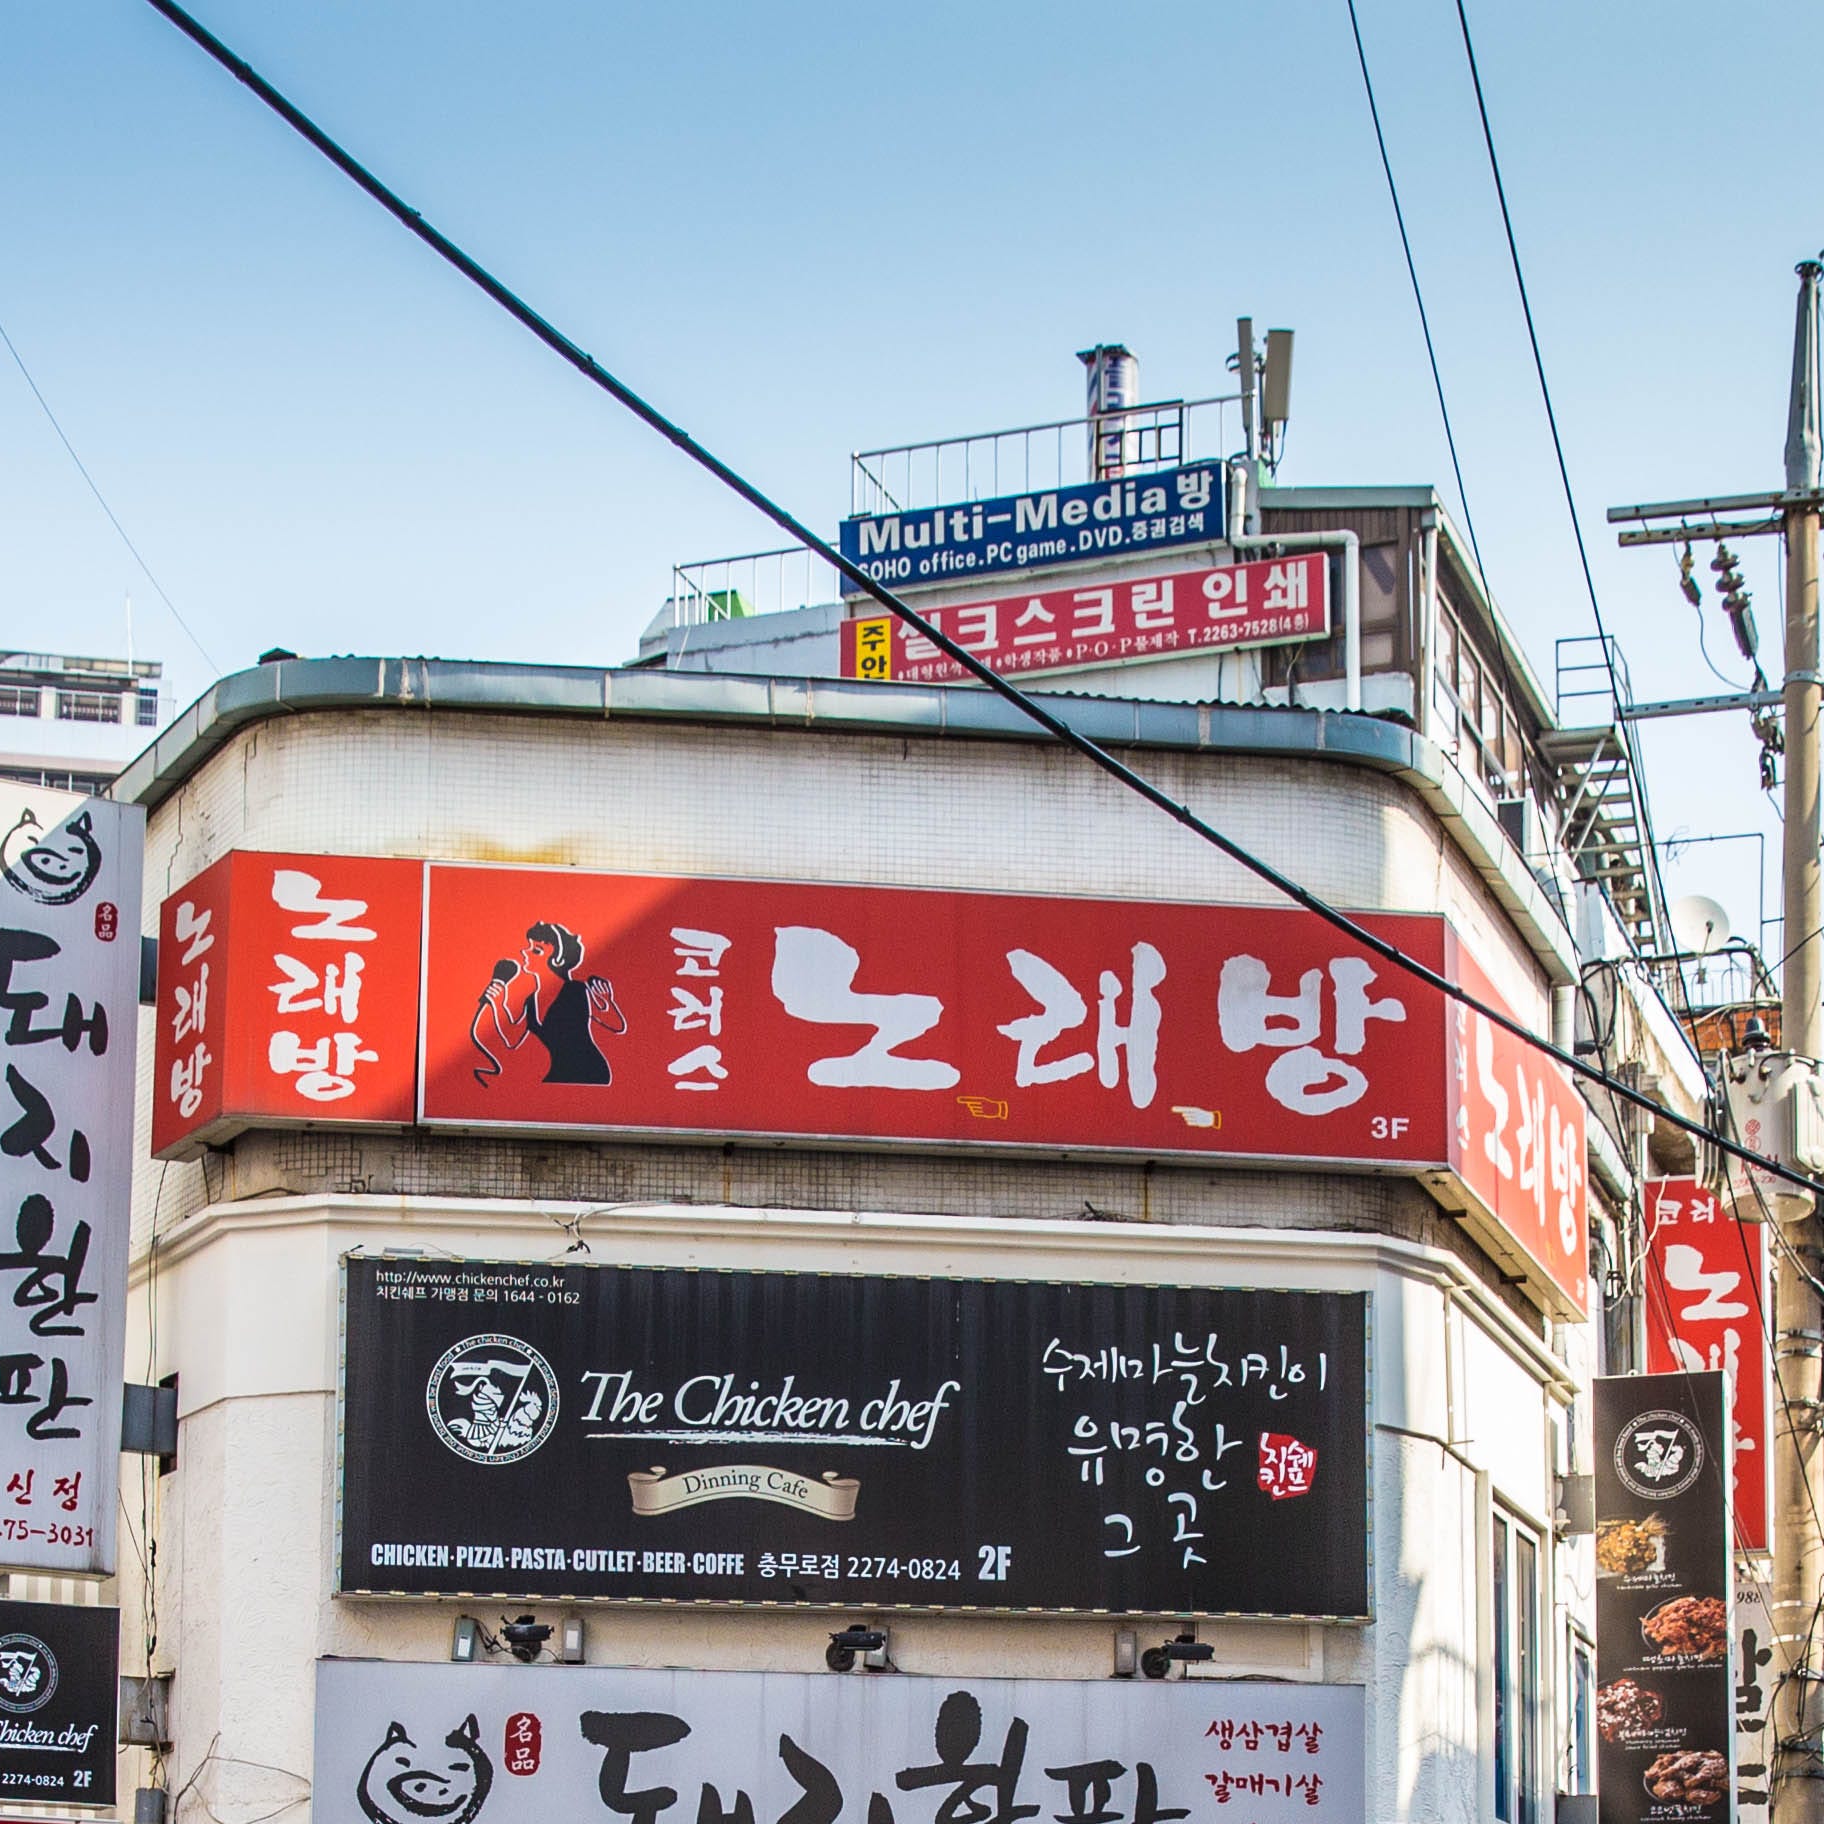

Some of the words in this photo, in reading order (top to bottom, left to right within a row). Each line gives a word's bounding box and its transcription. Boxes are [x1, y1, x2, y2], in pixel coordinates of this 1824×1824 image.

[858, 482, 1174, 556] Multi-Media
[1177, 470, 1214, 512] 방
[1201, 565, 1308, 618] 인쇄
[170, 899, 215, 1120] 노래방
[268, 868, 379, 1101] 노래방
[773, 925, 1407, 1116] 노래방
[1371, 1117, 1411, 1140] 3F
[1476, 1012, 1582, 1257] 노래방
[376, 1270, 565, 1289] http://www.chickenchef.co.kr
[503, 1290, 535, 1303] 1644
[548, 1290, 580, 1304] 0162
[581, 1371, 658, 1424] The
[674, 1372, 853, 1431] Chicken
[859, 1379, 962, 1449] chef
[1067, 1401, 1244, 1490] 유명한
[683, 1471, 762, 1497] Dinning
[766, 1472, 810, 1500] Cafe
[1103, 1515, 1141, 1558] 그
[1167, 1493, 1208, 1571] 곳
[757, 1552, 840, 1580] 충무로점
[847, 1557, 962, 1581] 2274-0824
[978, 1545, 1012, 1581] 2F
[56, 1722, 98, 1752] chef
[509, 1715, 536, 1772] 名品
[1204, 1719, 1323, 1757] 생삼겹살
[1, 1772, 65, 1788] 2274-0824
[73, 1769, 93, 1789] 2F
[1204, 1768, 1323, 1806] 갈매기살
